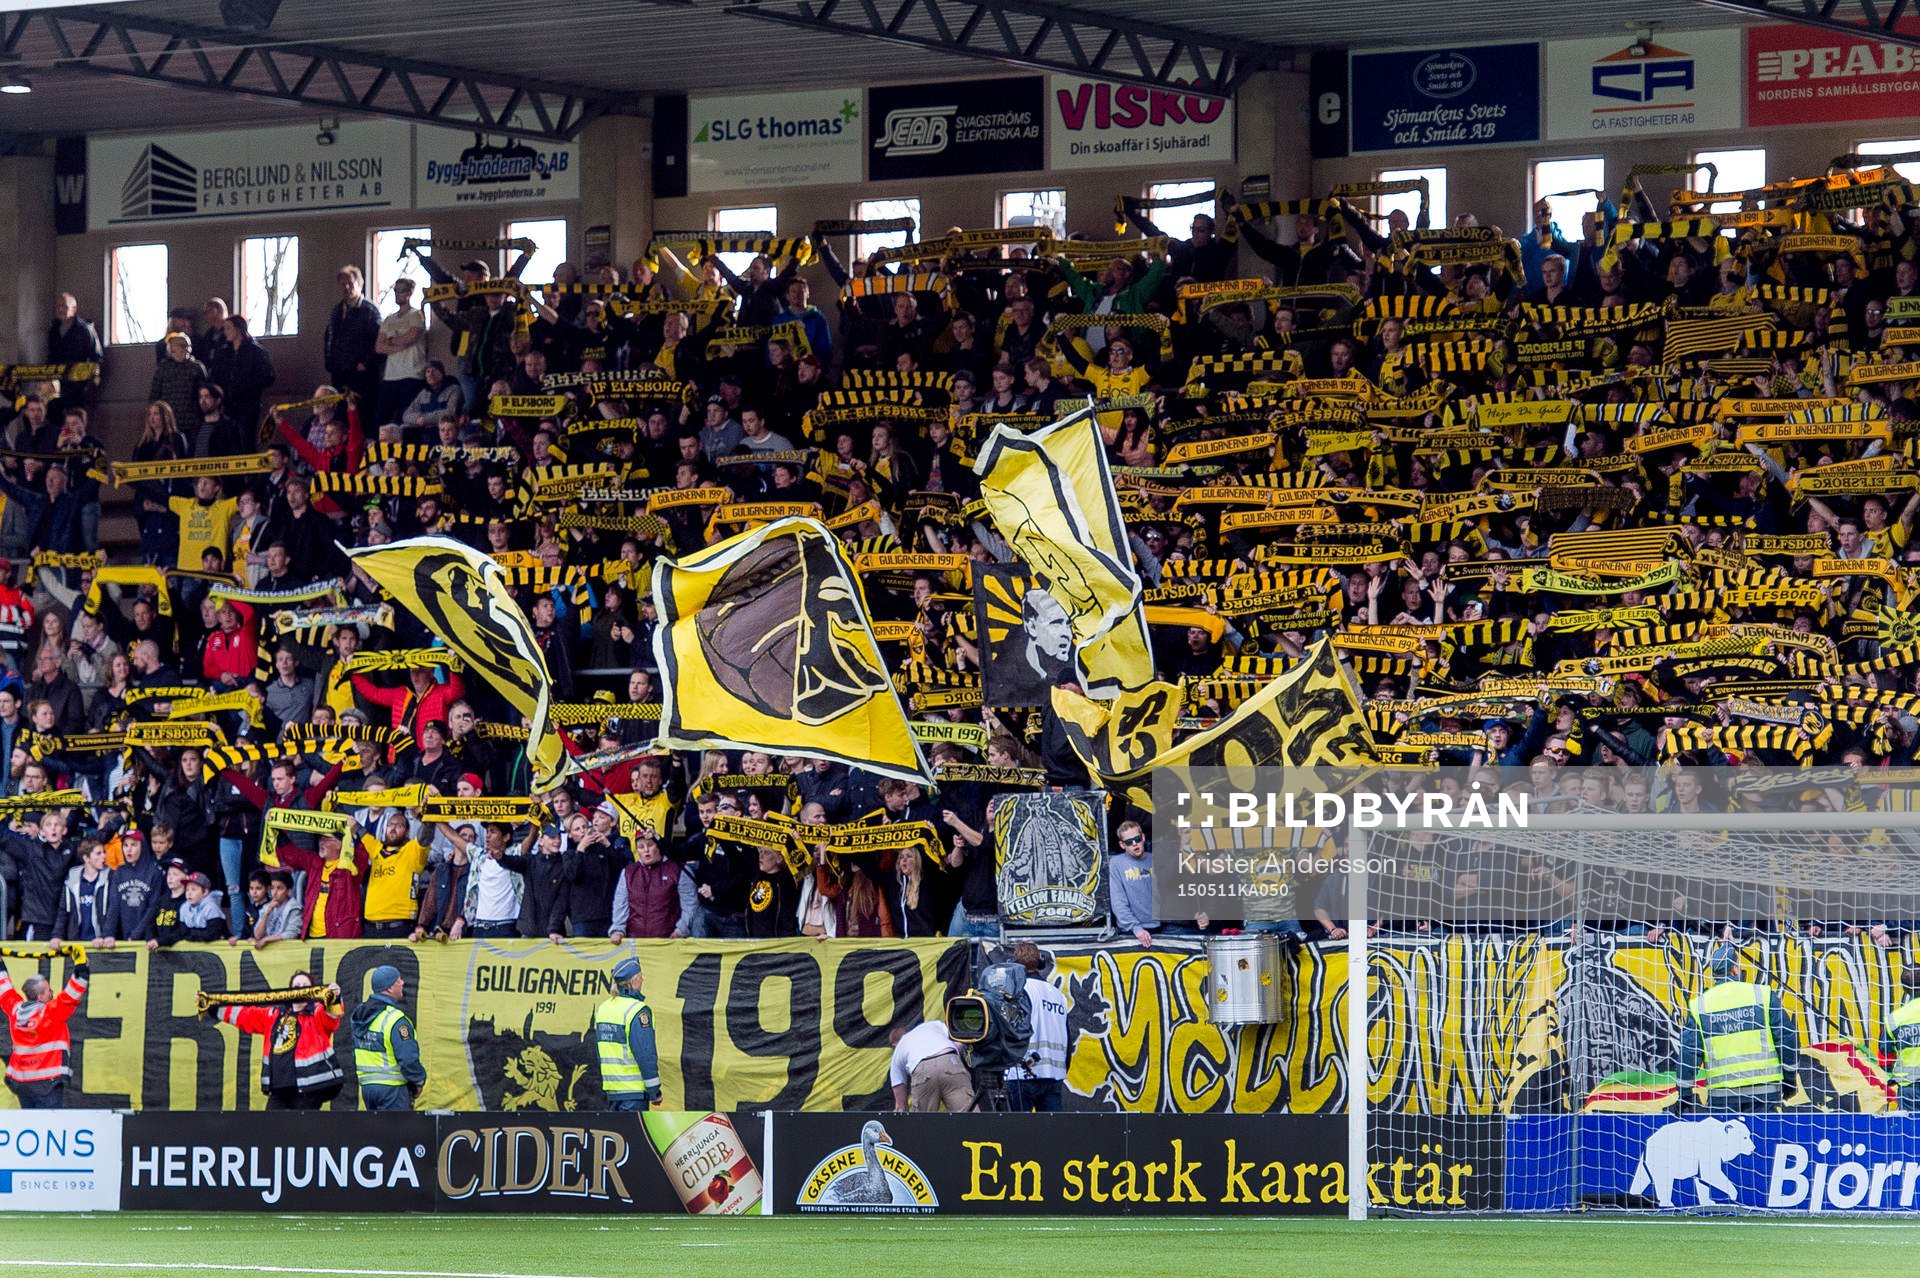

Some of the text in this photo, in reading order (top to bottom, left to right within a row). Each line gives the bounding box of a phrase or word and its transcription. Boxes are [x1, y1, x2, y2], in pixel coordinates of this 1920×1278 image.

[1764, 44, 1914, 82] PEAB
[1758, 87, 1814, 101] NORDENS
[955, 111, 1032, 129] SVAGSTRÖMS
[1383, 103, 1507, 131] Sjömarkens Svets
[1592, 113, 1695, 130] CA FASTIGHETER AB
[711, 116, 842, 142] SLG thomas
[955, 125, 1039, 144] ELEKTRISKA AB
[1394, 123, 1496, 144] och Smide AB
[1070, 142, 1090, 155] Din
[1093, 137, 1144, 154] skoaffär
[1153, 134, 1211, 153] Sjuhärad!
[203, 157, 383, 190] BERGLUND & NILSSON
[203, 182, 382, 207] FASTIGHETER AB
[1419, 227, 1492, 241] ELFSBORG
[1784, 236, 1836, 248] GULIGANERNA
[1859, 365, 1911, 378] GULIGANERNA
[593, 381, 683, 394] IF ELFSBORG
[856, 406, 927, 418] ELFSBORG
[1433, 436, 1495, 448] ELFSBORG
[1644, 429, 1690, 446] GULIGANERNA
[1195, 438, 1249, 454] GULIGANERNA
[1500, 473, 1586, 484] IF ELFSBORG
[658, 492, 707, 504] GULIGANERNA
[1201, 488, 1255, 499] GULIGANERNA
[732, 506, 804, 517] GULIGANERNA 1991
[1242, 509, 1315, 523] GULIGANERNA 1991
[1294, 545, 1383, 557] IF ELFSBORG
[1747, 538, 1760, 549] IF
[880, 555, 954, 565] GULIGANERNA 1991
[1576, 560, 1632, 572] GULIGANERNA
[1822, 560, 1864, 571] GULIGANERNA
[1648, 565, 1672, 581] 1991
[1727, 590, 1818, 602] IF ELFSBORG
[1380, 626, 1438, 637] GULIGANERNA
[1675, 658, 1778, 677] ELFSBORG
[143, 729, 208, 739] ELFSBORG
[958, 724, 983, 742] 1991
[440, 804, 516, 815] IF ELFSBORG
[714, 820, 787, 845] IF ELFSBORG
[835, 829, 921, 846] IF ELFSBORG
[476, 965, 613, 996] GULIGANERN
[535, 1001, 556, 1014] 1991
[1042, 999, 1065, 1016] FOTO
[1710, 1008, 1755, 1024] ORDNINGS
[674, 1129, 721, 1169] HERRLJUNGA
[437, 1126, 634, 1203] CIDER
[682, 1141, 731, 1189] CIDER
[961, 1140, 1042, 1201] En
[1063, 1139, 1207, 1203] stark
[808, 1152, 928, 1200] GÄSENE MEJERI
[20, 1180, 95, 1191] SINCE 1992
